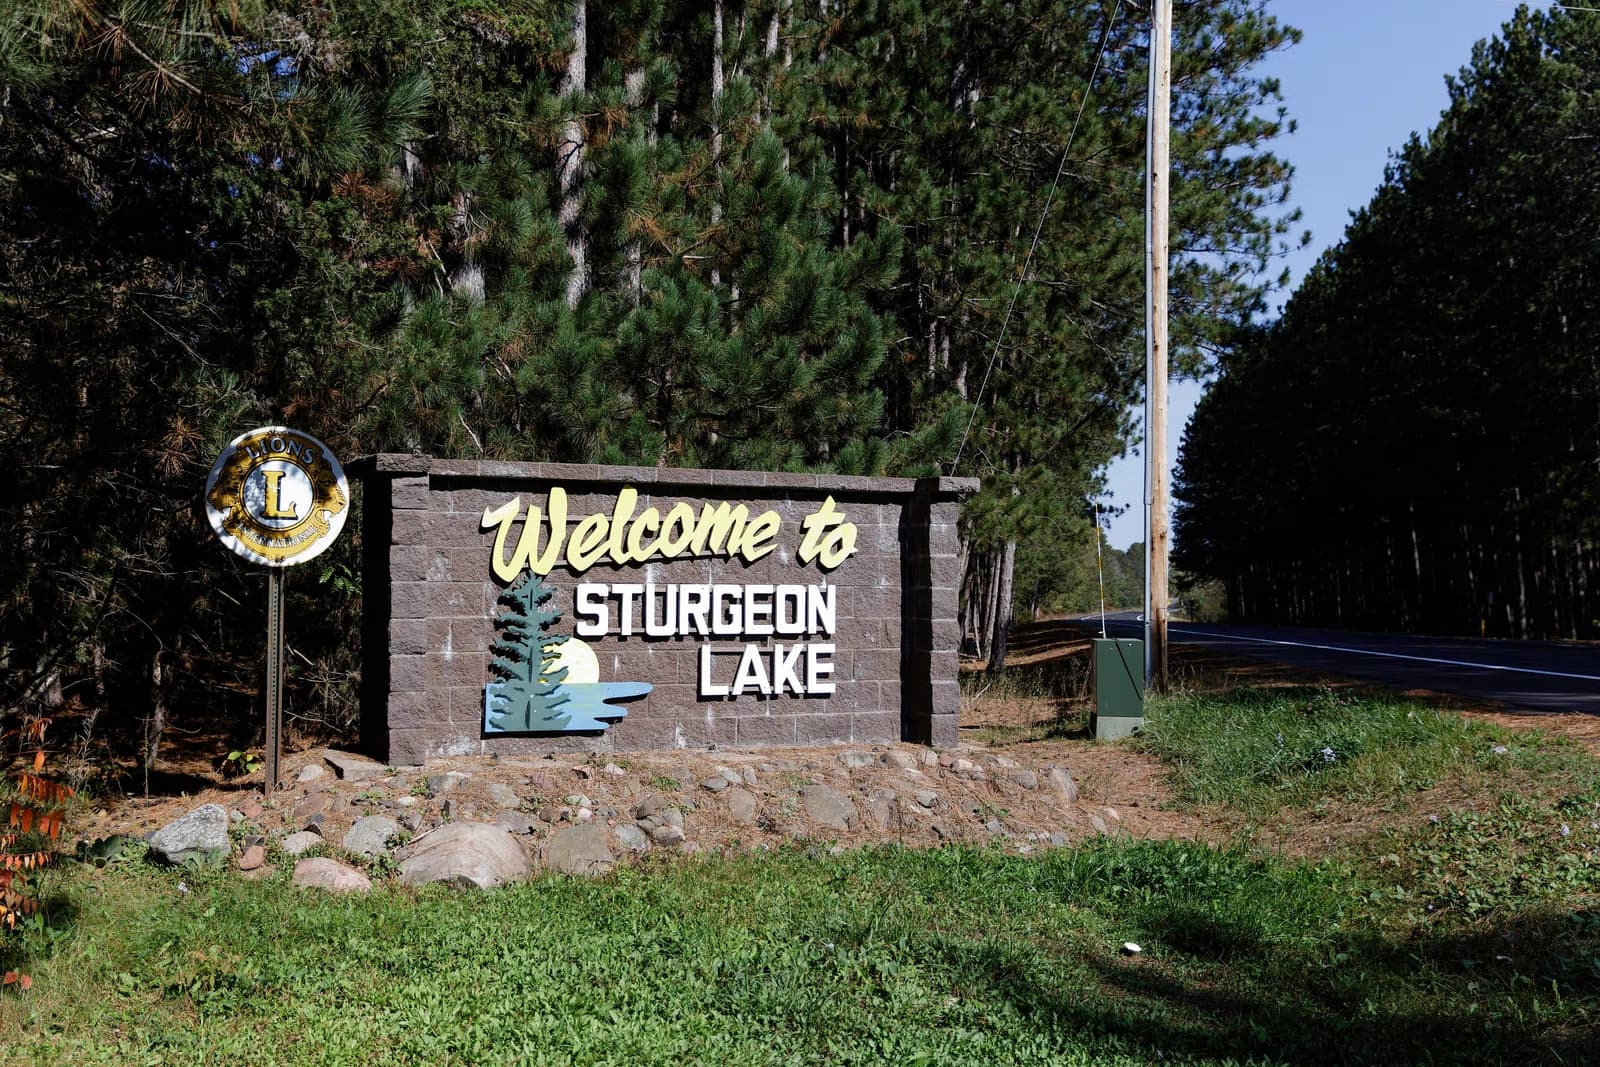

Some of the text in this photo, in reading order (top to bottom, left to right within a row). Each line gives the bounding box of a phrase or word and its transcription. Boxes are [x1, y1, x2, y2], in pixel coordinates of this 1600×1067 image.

[245, 437, 316, 464] LIONS
[261, 470, 299, 520] L
[237, 523, 318, 548] INTERNATIONAL
[481, 484, 859, 582] Welcome to
[576, 583, 836, 636] STURGEON
[701, 643, 836, 696] LAKE
